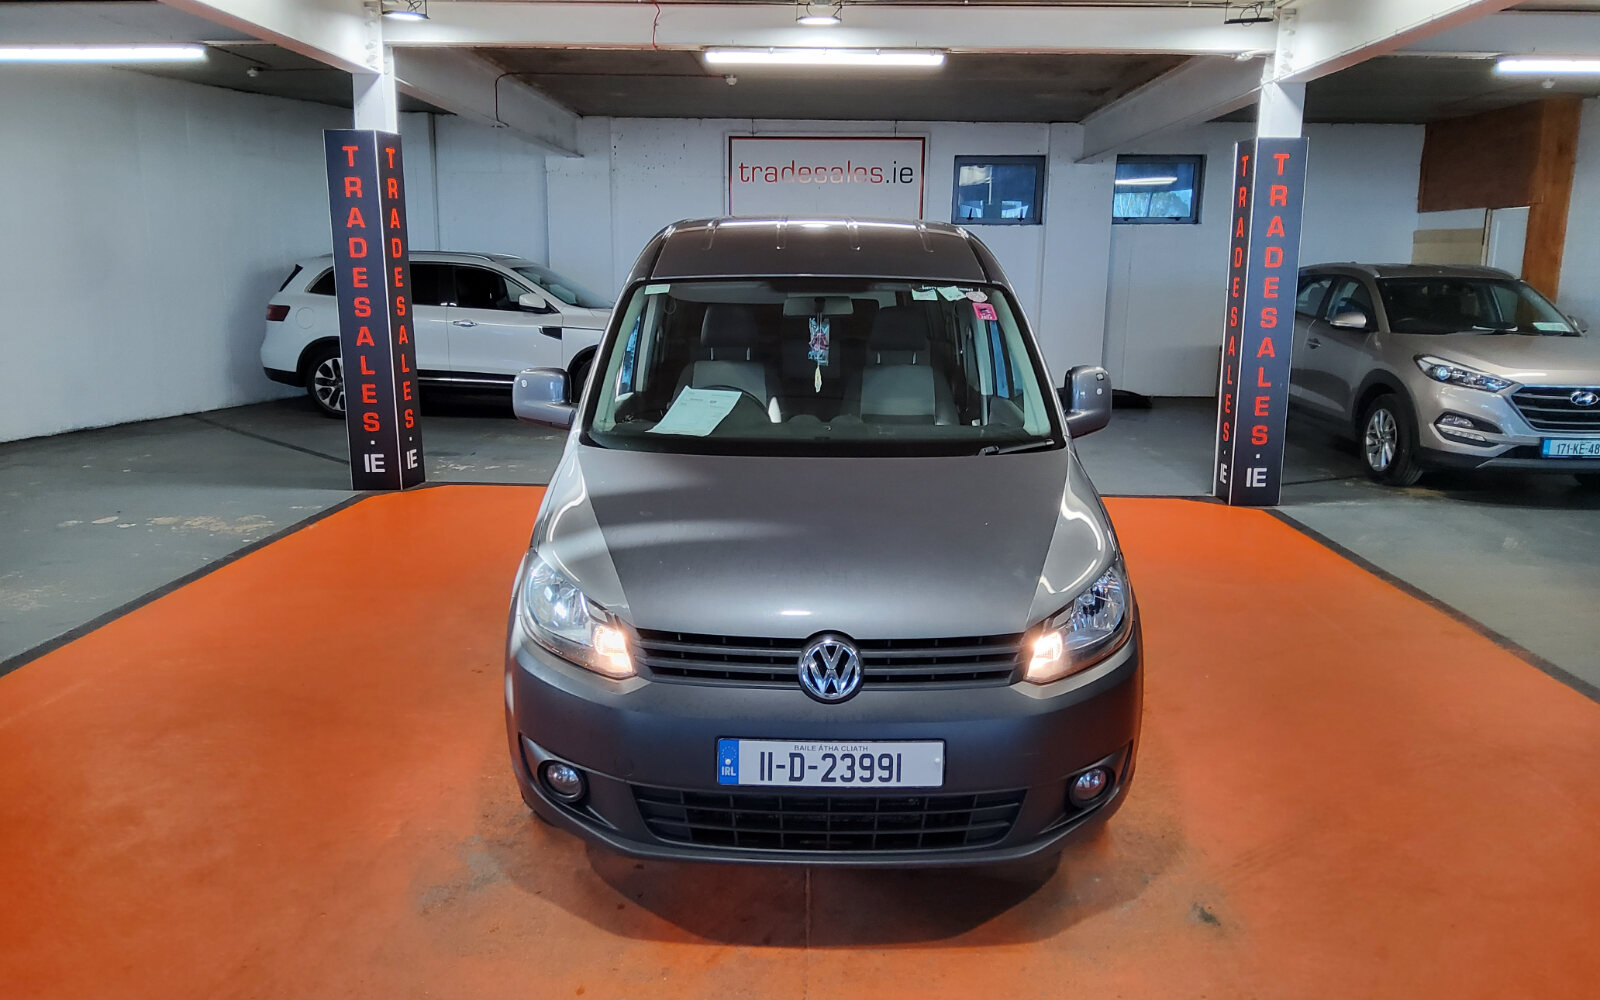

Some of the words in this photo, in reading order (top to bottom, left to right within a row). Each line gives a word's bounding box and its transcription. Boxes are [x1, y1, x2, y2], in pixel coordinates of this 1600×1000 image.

[738, 160, 914, 184] tradesales.ie
[803, 641, 860, 699] VW
[721, 766, 737, 777] IRL
[759, 751, 902, 783] 11-D-23991
